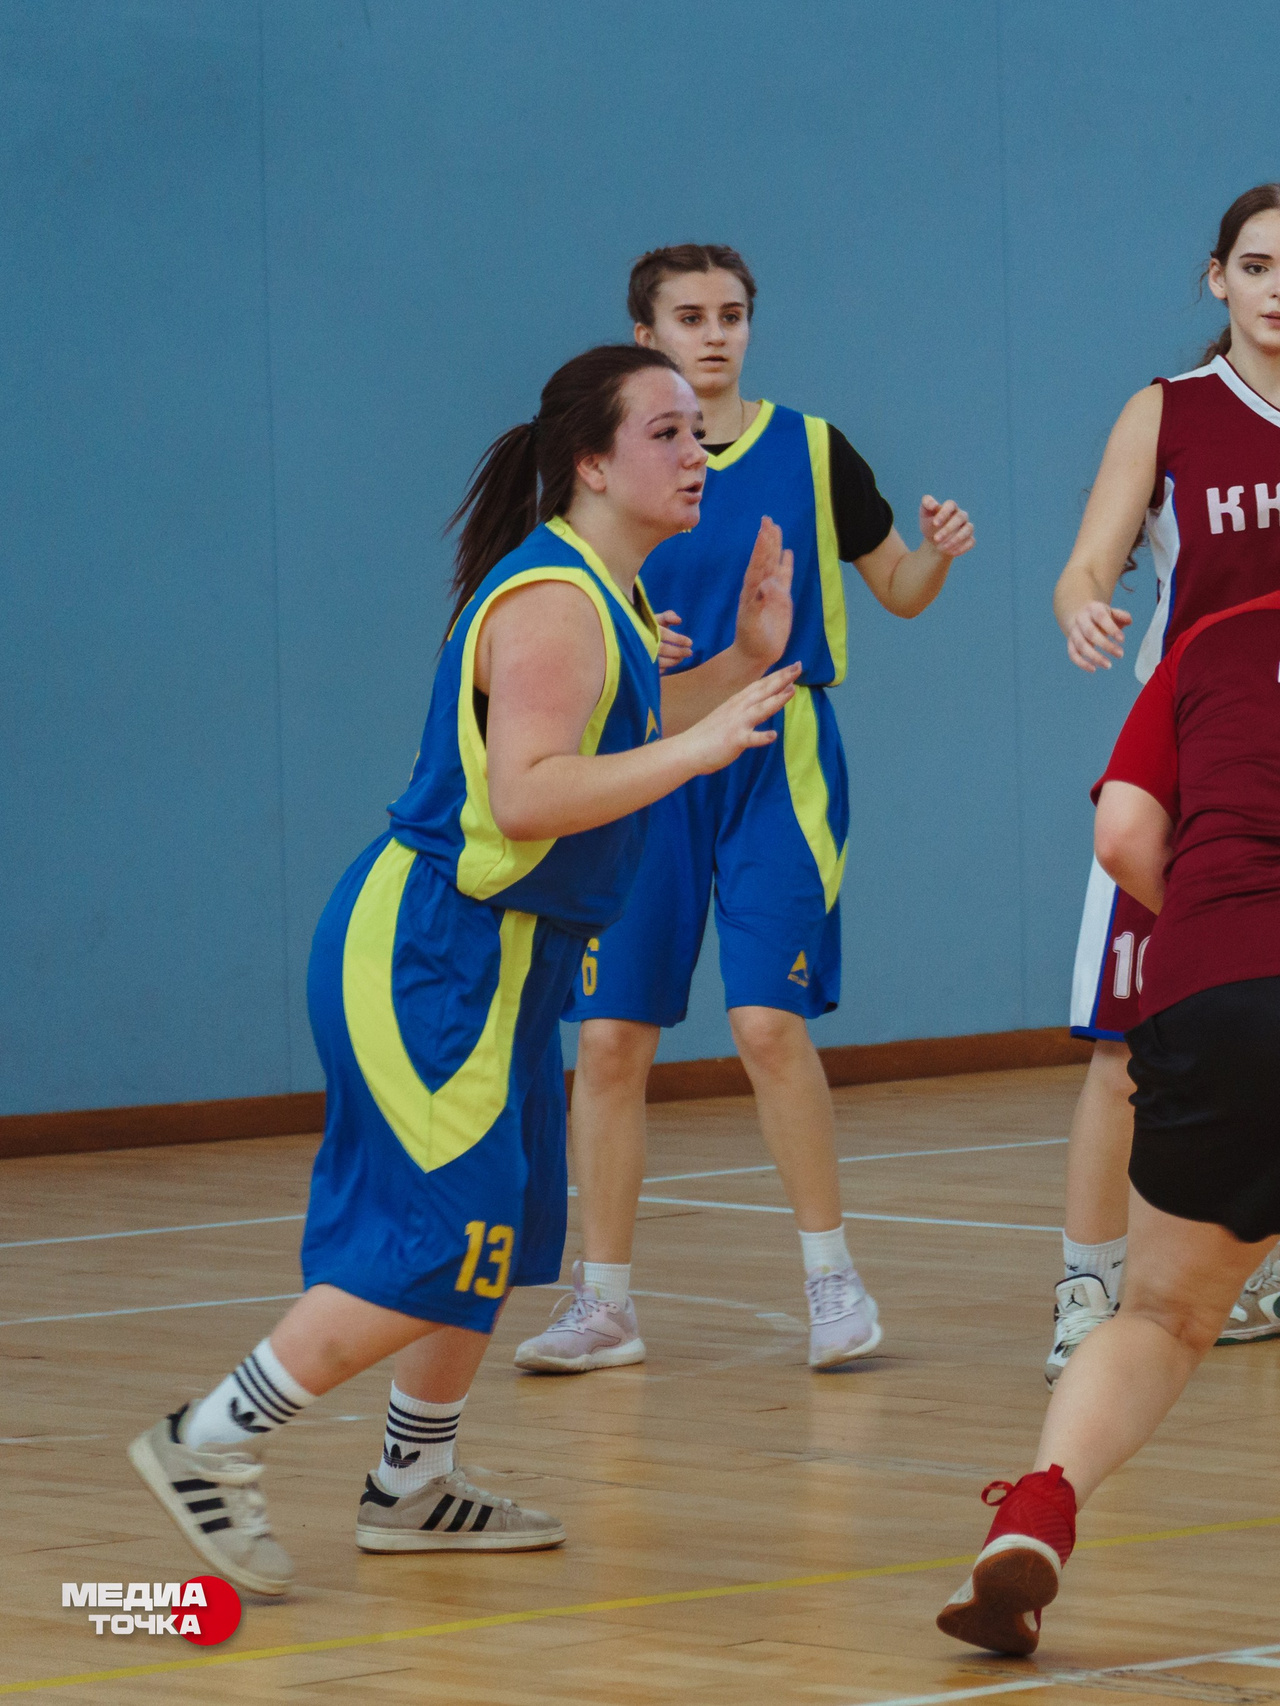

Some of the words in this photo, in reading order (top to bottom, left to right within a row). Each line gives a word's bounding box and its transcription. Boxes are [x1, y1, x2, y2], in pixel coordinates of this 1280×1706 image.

[581, 937, 600, 996] 6
[1112, 931, 1152, 1000] 1
[454, 1220, 515, 1299] 13
